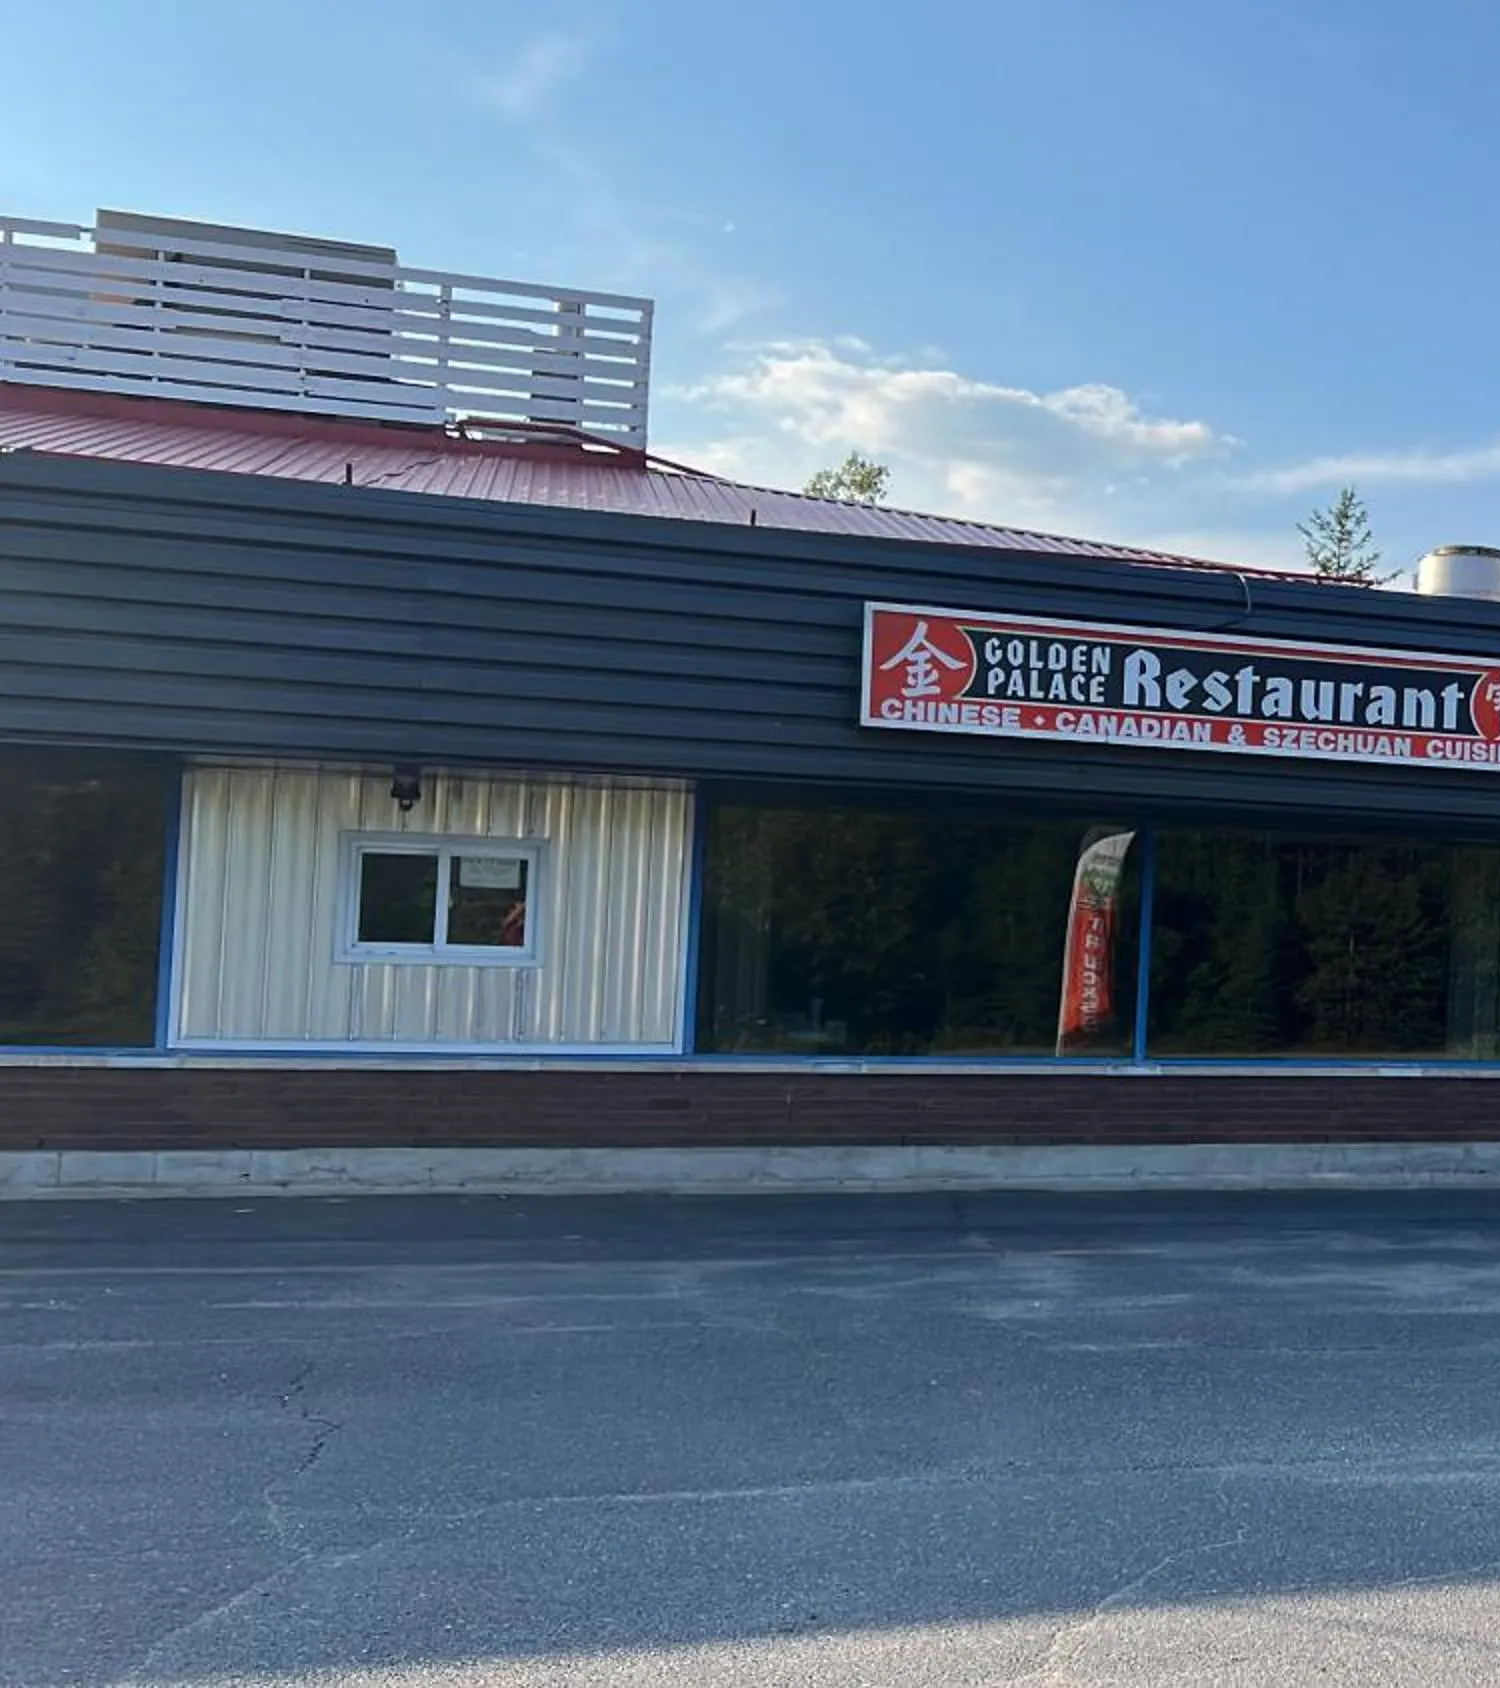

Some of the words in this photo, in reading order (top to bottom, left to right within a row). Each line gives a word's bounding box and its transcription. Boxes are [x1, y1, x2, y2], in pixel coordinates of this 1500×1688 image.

[879, 620, 968, 697] 金
[984, 637, 1111, 675] GOLDEN
[987, 667, 1105, 703] PALACE
[1123, 648, 1465, 730] Restaurant
[880, 698, 1021, 728] CHINESE
[1055, 711, 1212, 744] CANADIAN
[1227, 724, 1246, 746] &
[1263, 727, 1412, 757] SZECHUAN
